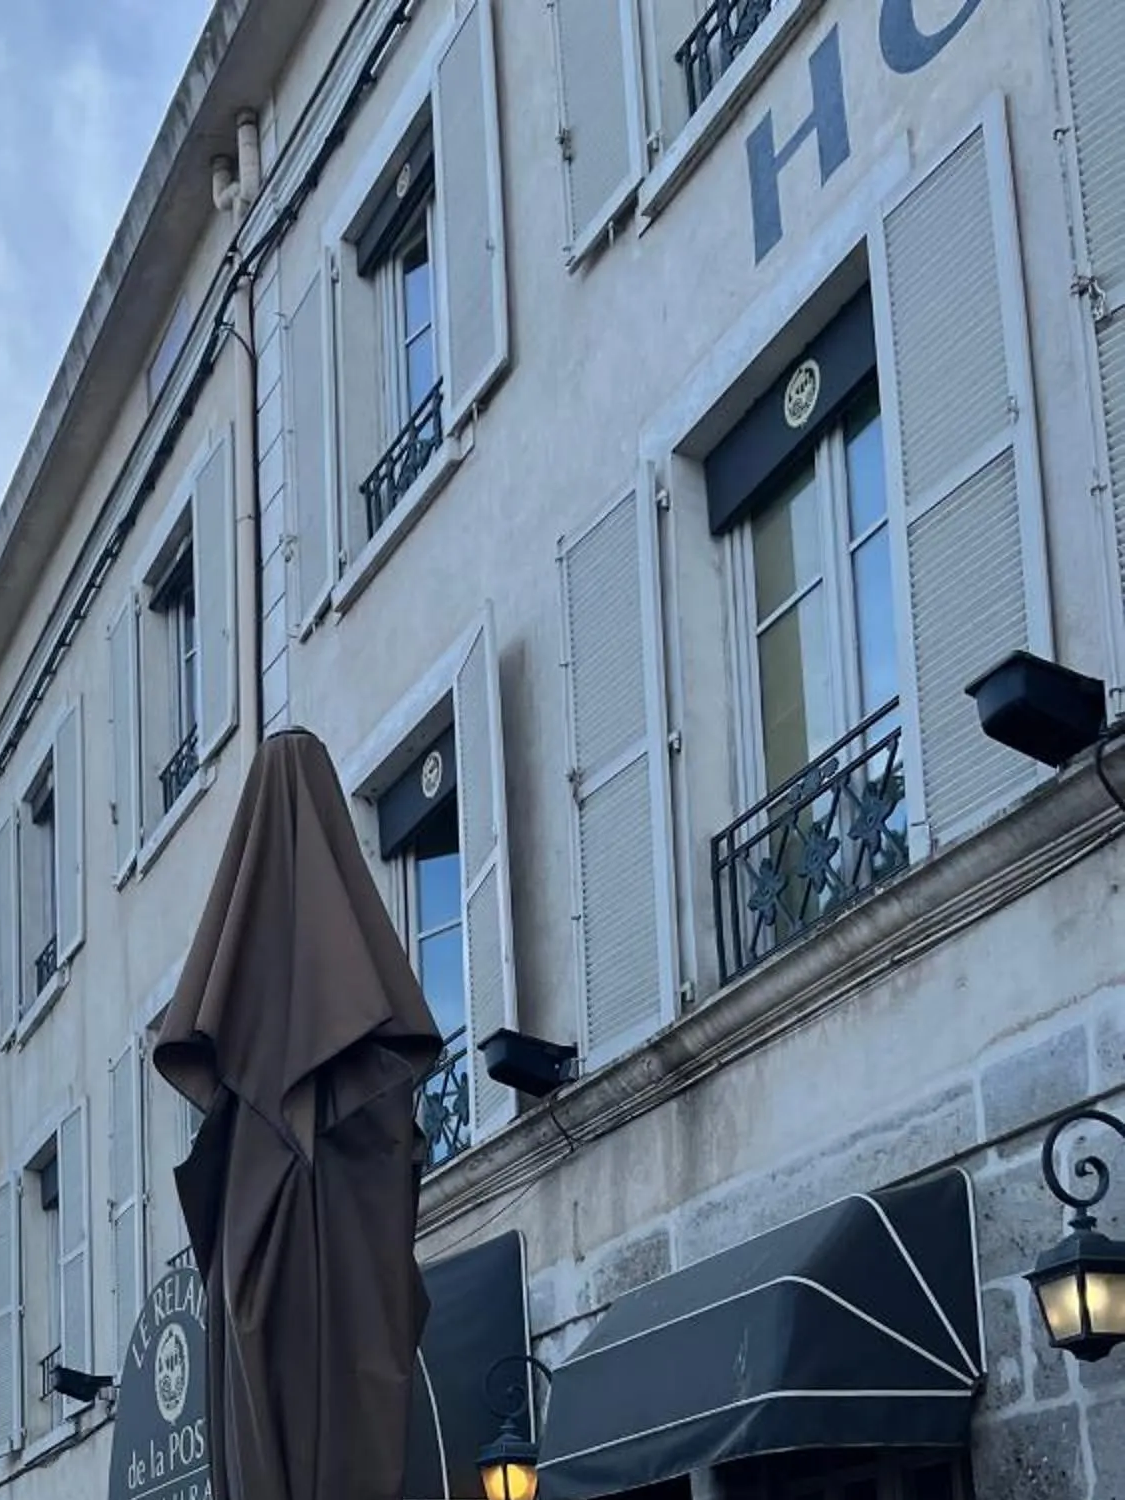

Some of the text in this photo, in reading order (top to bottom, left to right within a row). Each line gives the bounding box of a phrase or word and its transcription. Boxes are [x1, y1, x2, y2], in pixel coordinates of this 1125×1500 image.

[131, 1312, 152, 1369] LE
[128, 1449, 146, 1490] de
[150, 1439, 165, 1479] la
